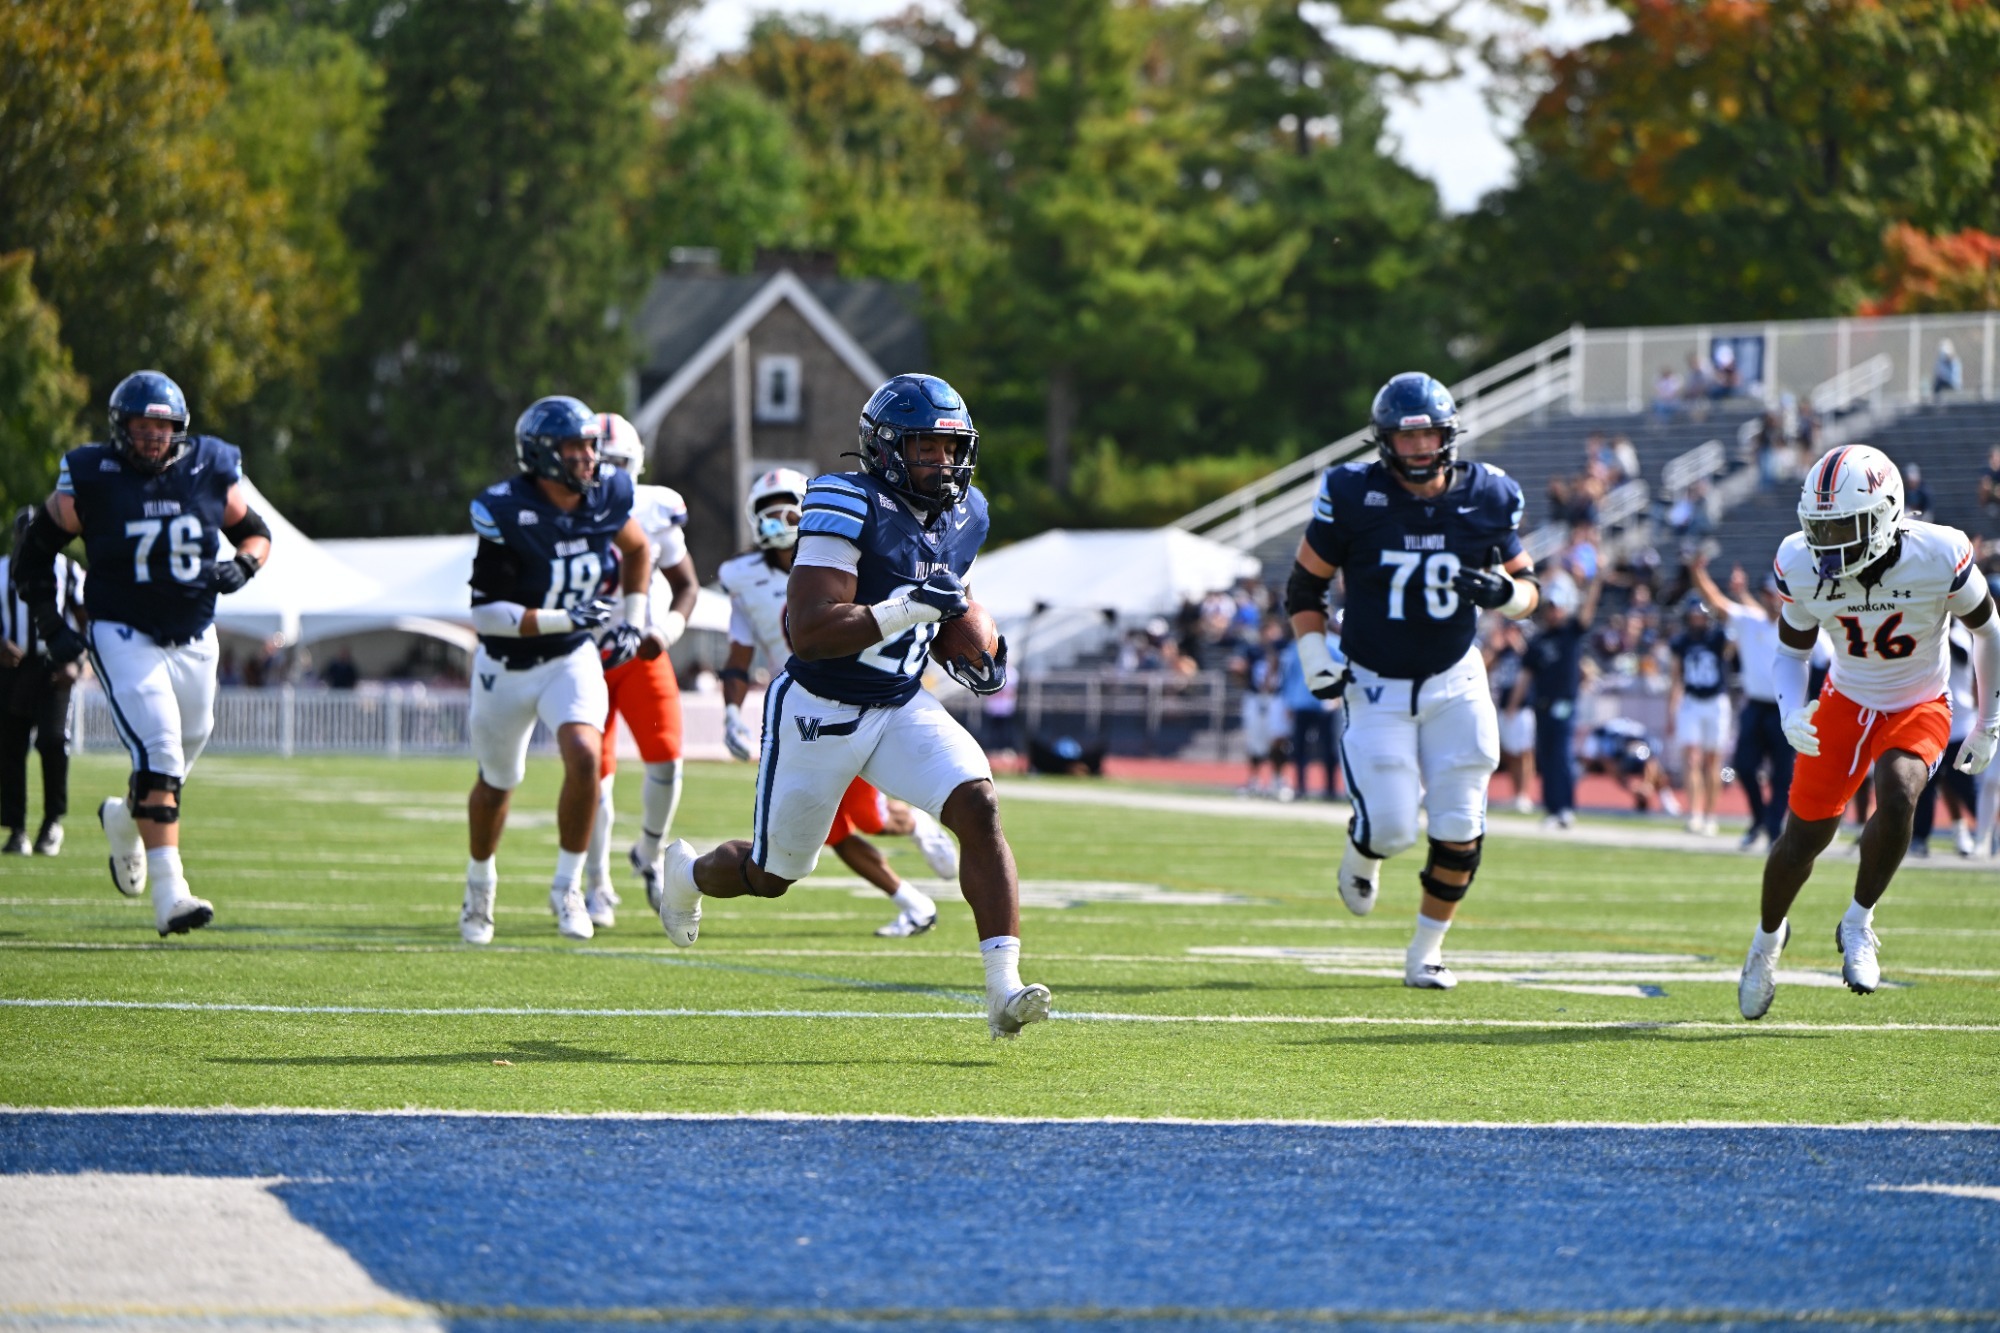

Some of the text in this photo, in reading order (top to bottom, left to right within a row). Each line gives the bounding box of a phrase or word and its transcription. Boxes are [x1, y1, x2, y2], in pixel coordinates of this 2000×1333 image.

[125, 515, 204, 583] 76
[542, 553, 603, 611] 19
[1379, 550, 1461, 620] 78
[1847, 602, 1896, 612] MORGAN
[1834, 611, 1917, 660] 16
[793, 715, 824, 742] V
